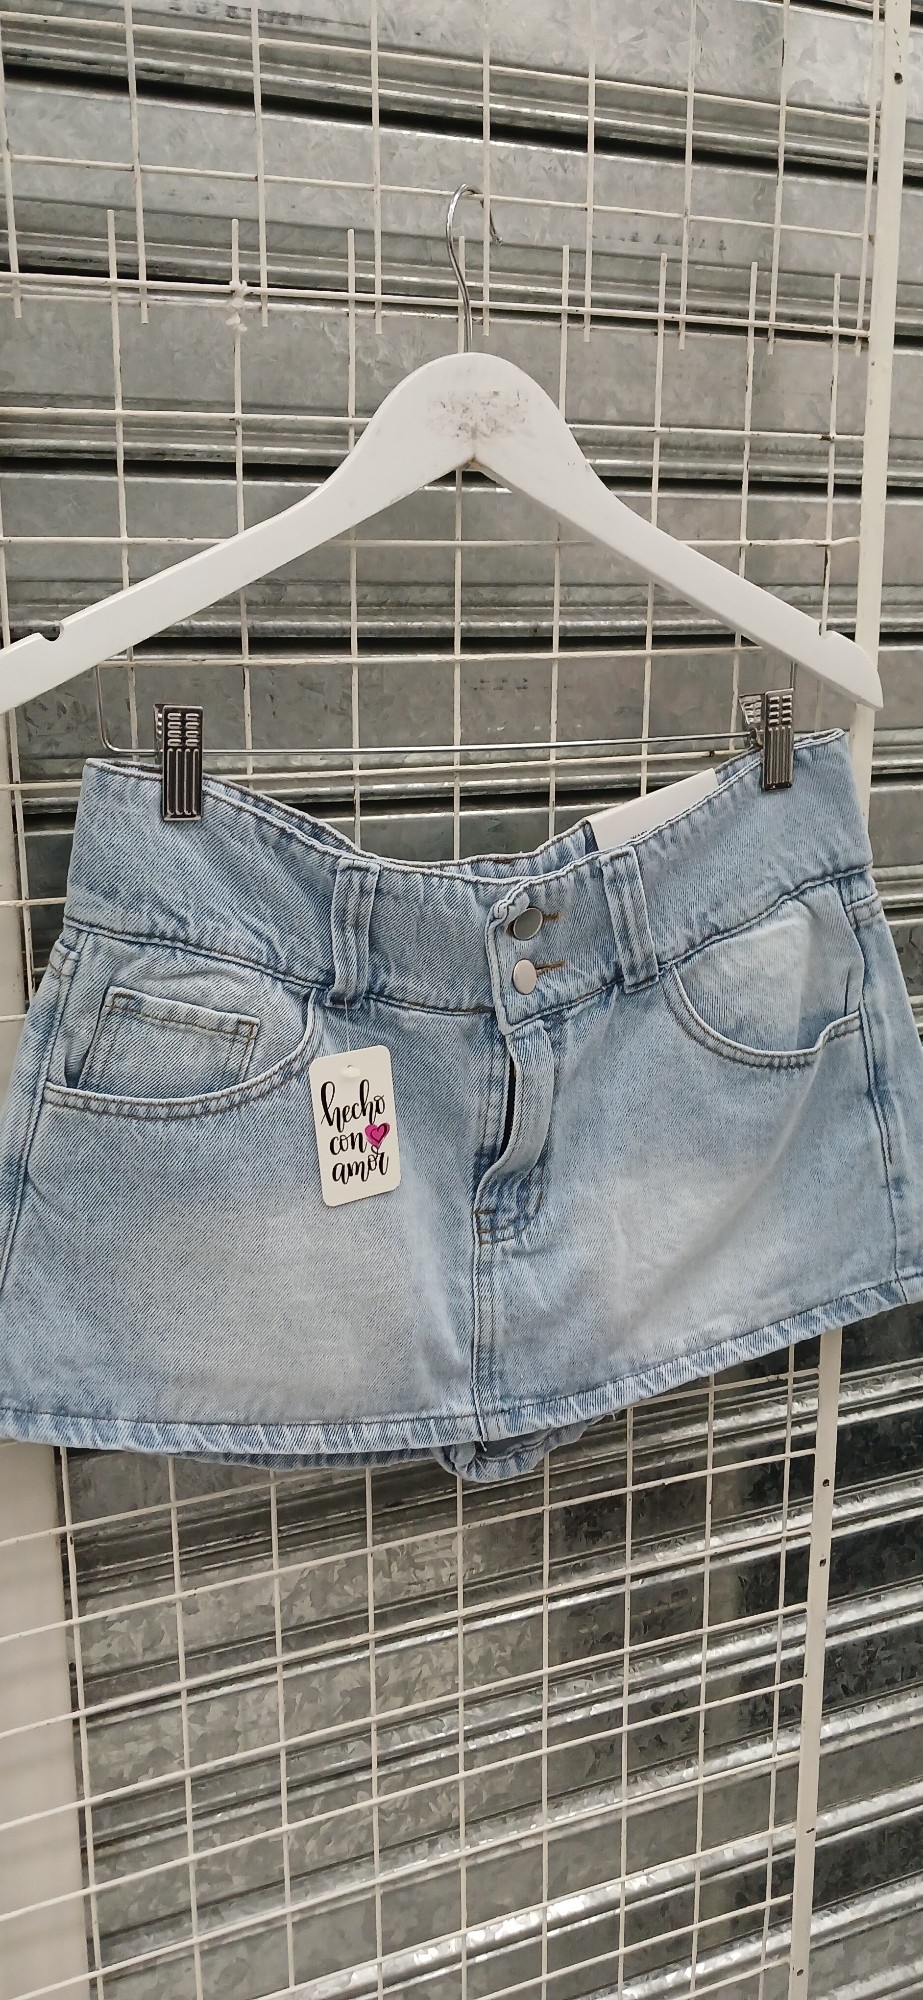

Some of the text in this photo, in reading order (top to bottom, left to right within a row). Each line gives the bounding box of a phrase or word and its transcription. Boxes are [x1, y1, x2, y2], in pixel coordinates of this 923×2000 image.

[320, 1079, 386, 1133] hecho
[329, 1131, 367, 1156] con
[332, 1146, 389, 1185] amor
